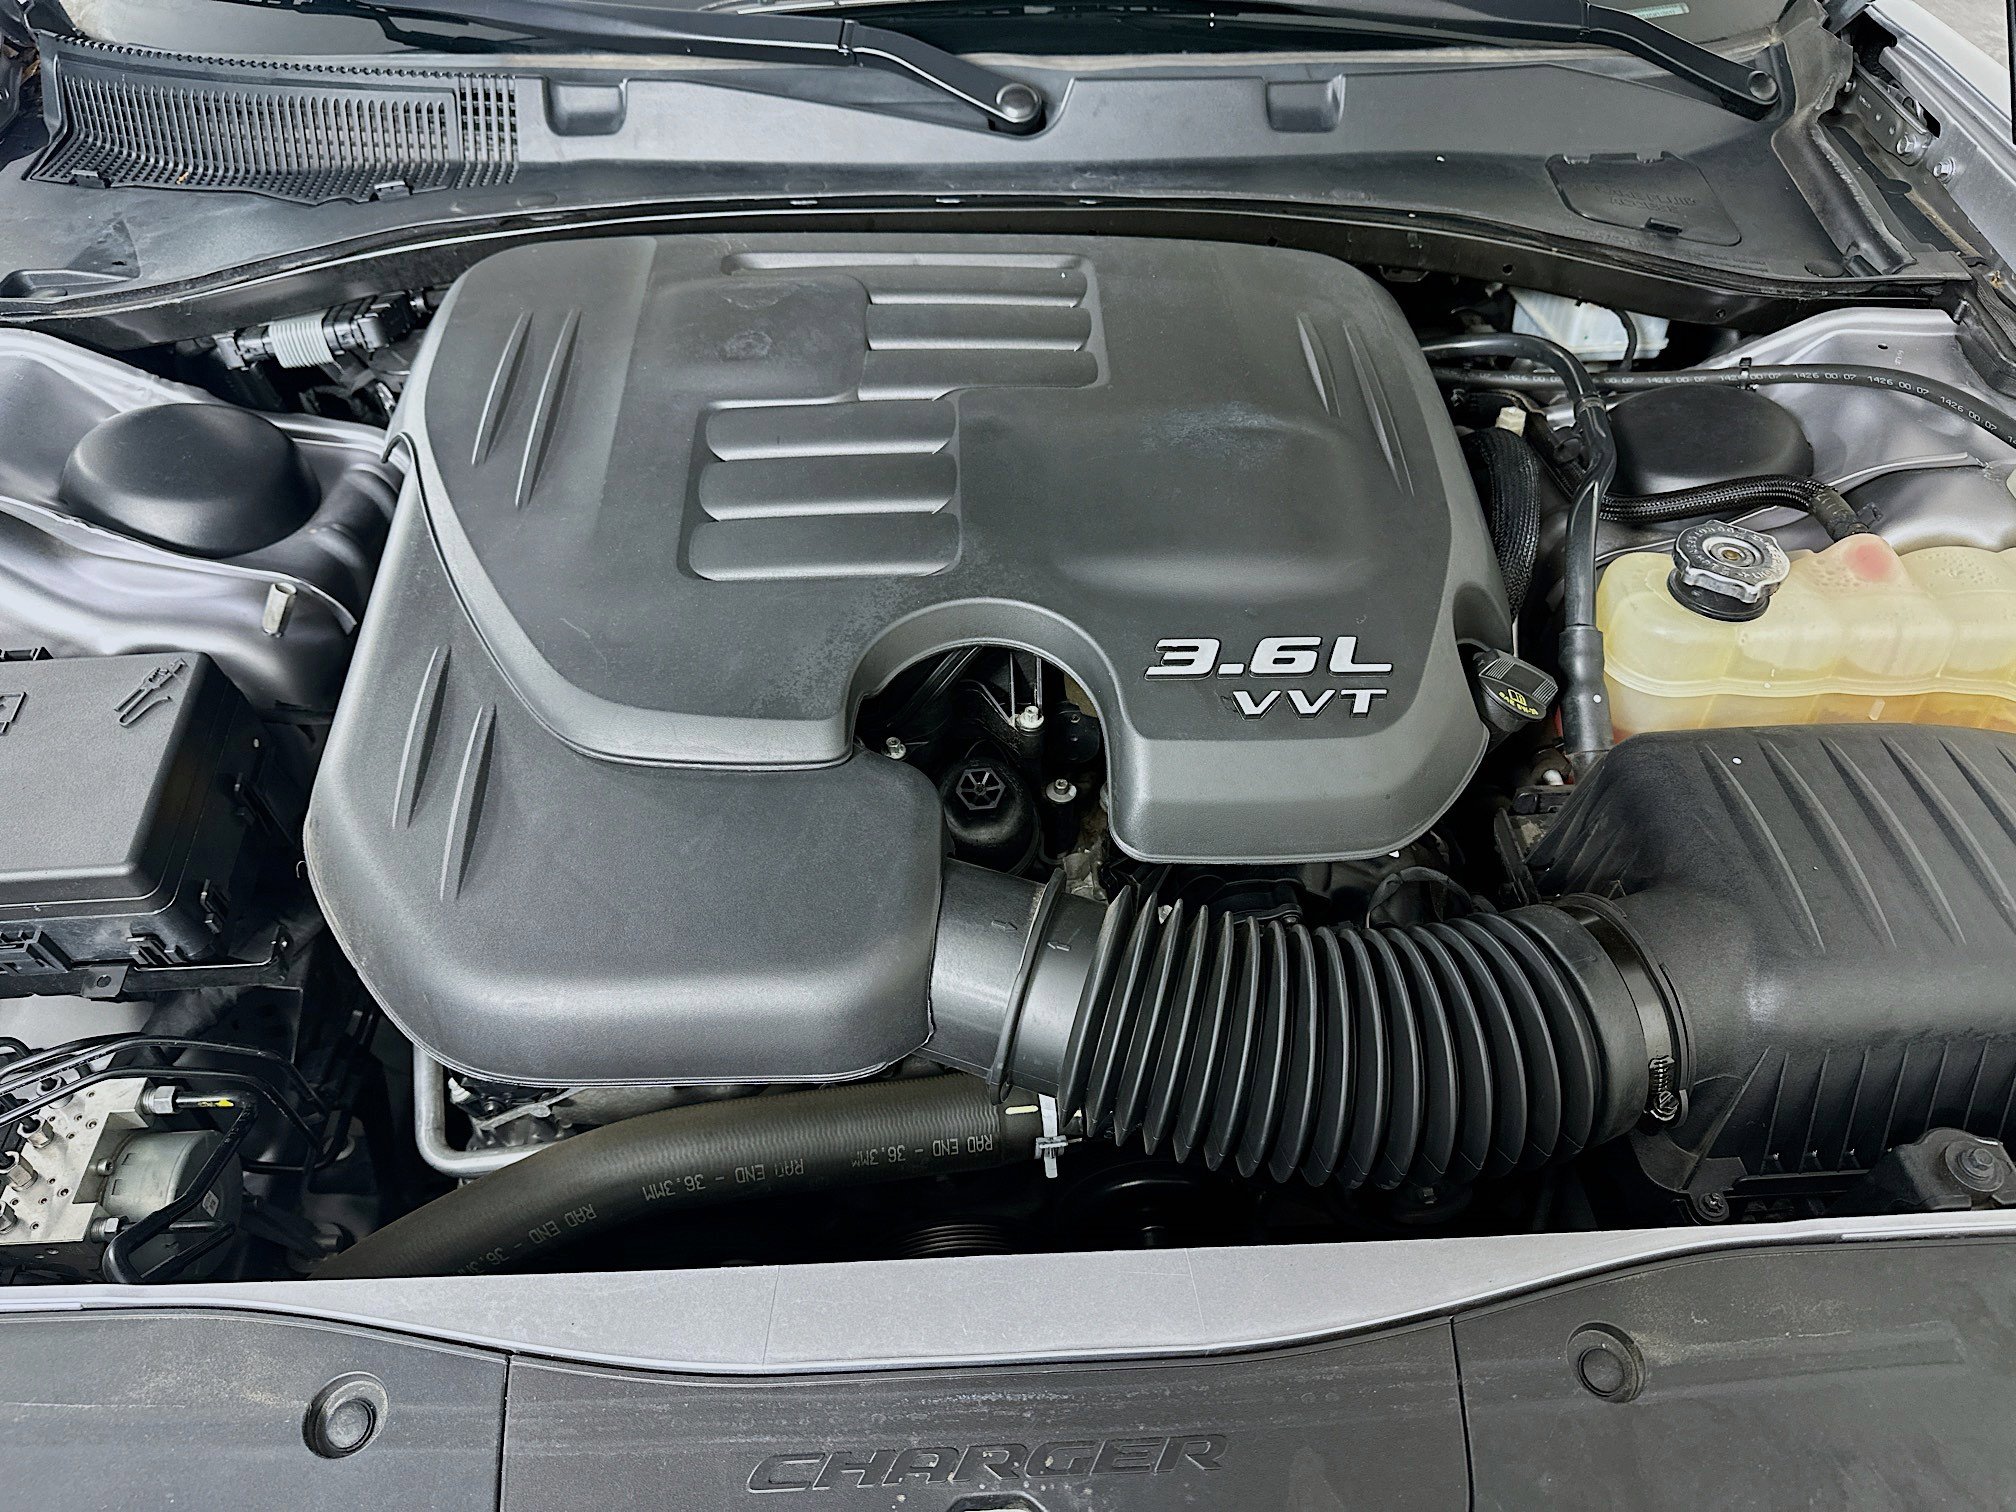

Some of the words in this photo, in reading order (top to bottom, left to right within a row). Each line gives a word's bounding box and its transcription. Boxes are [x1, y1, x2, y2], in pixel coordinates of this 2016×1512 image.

[1793, 371, 1820, 379] 1426
[1866, 375, 1894, 386] 1426
[1940, 396, 1965, 413] 1426
[1144, 635, 1394, 682] 3.6L
[1231, 688, 1389, 720] VVT
[932, 1137, 960, 1158] END
[966, 1133, 994, 1154] RAD
[851, 1144, 907, 1168] 36.3MM
[734, 1163, 766, 1184] END
[774, 1157, 805, 1179] RAD
[641, 1173, 707, 1202] 36.3MM
[564, 1203, 598, 1229] RAD
[528, 1219, 562, 1245] END
[746, 1433, 1229, 1494] CHARGER
